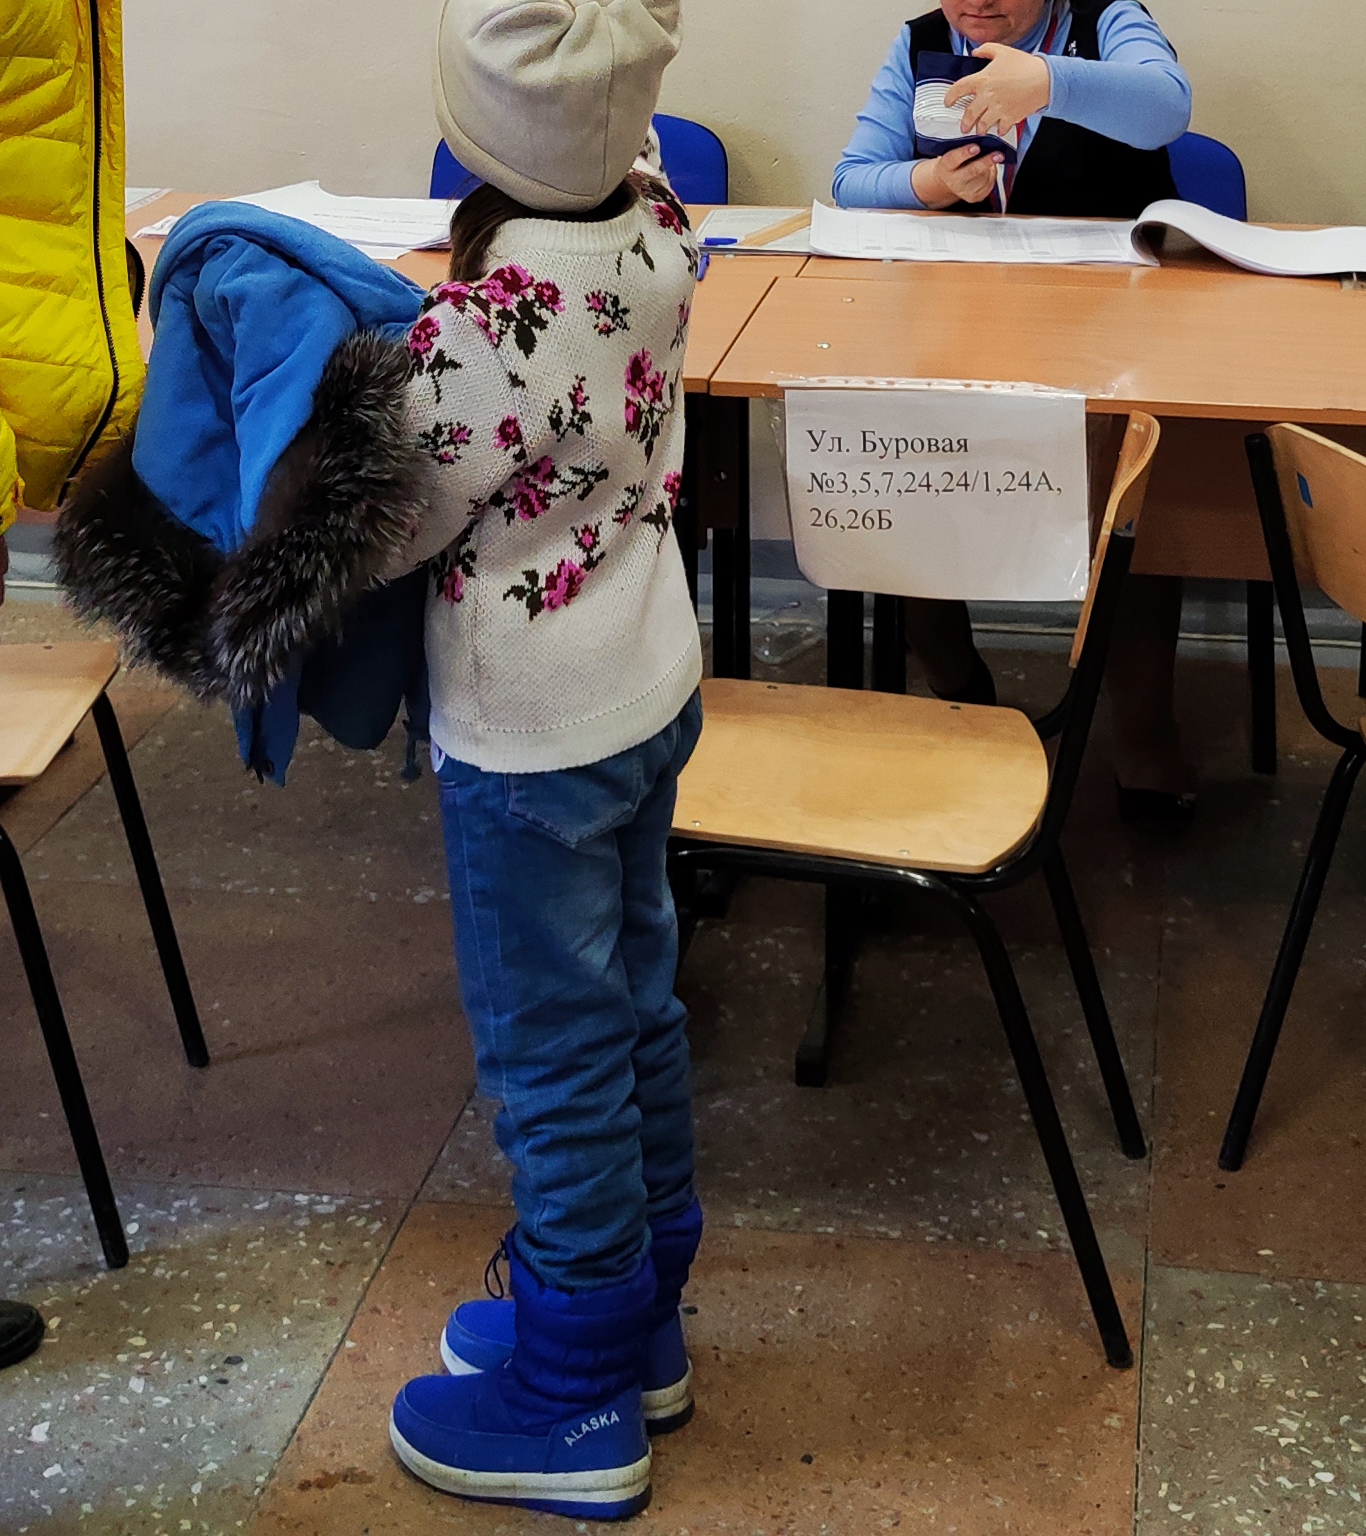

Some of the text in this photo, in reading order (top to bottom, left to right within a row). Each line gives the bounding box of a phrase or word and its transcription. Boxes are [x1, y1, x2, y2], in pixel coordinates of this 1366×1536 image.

[806, 429, 969, 459] Ул. Буровая
[807, 470, 1063, 496] №3,5,7,24,24/1,24А,
[809, 508, 893, 531] 26,26Б
[564, 1410, 620, 1447] ALASKA
